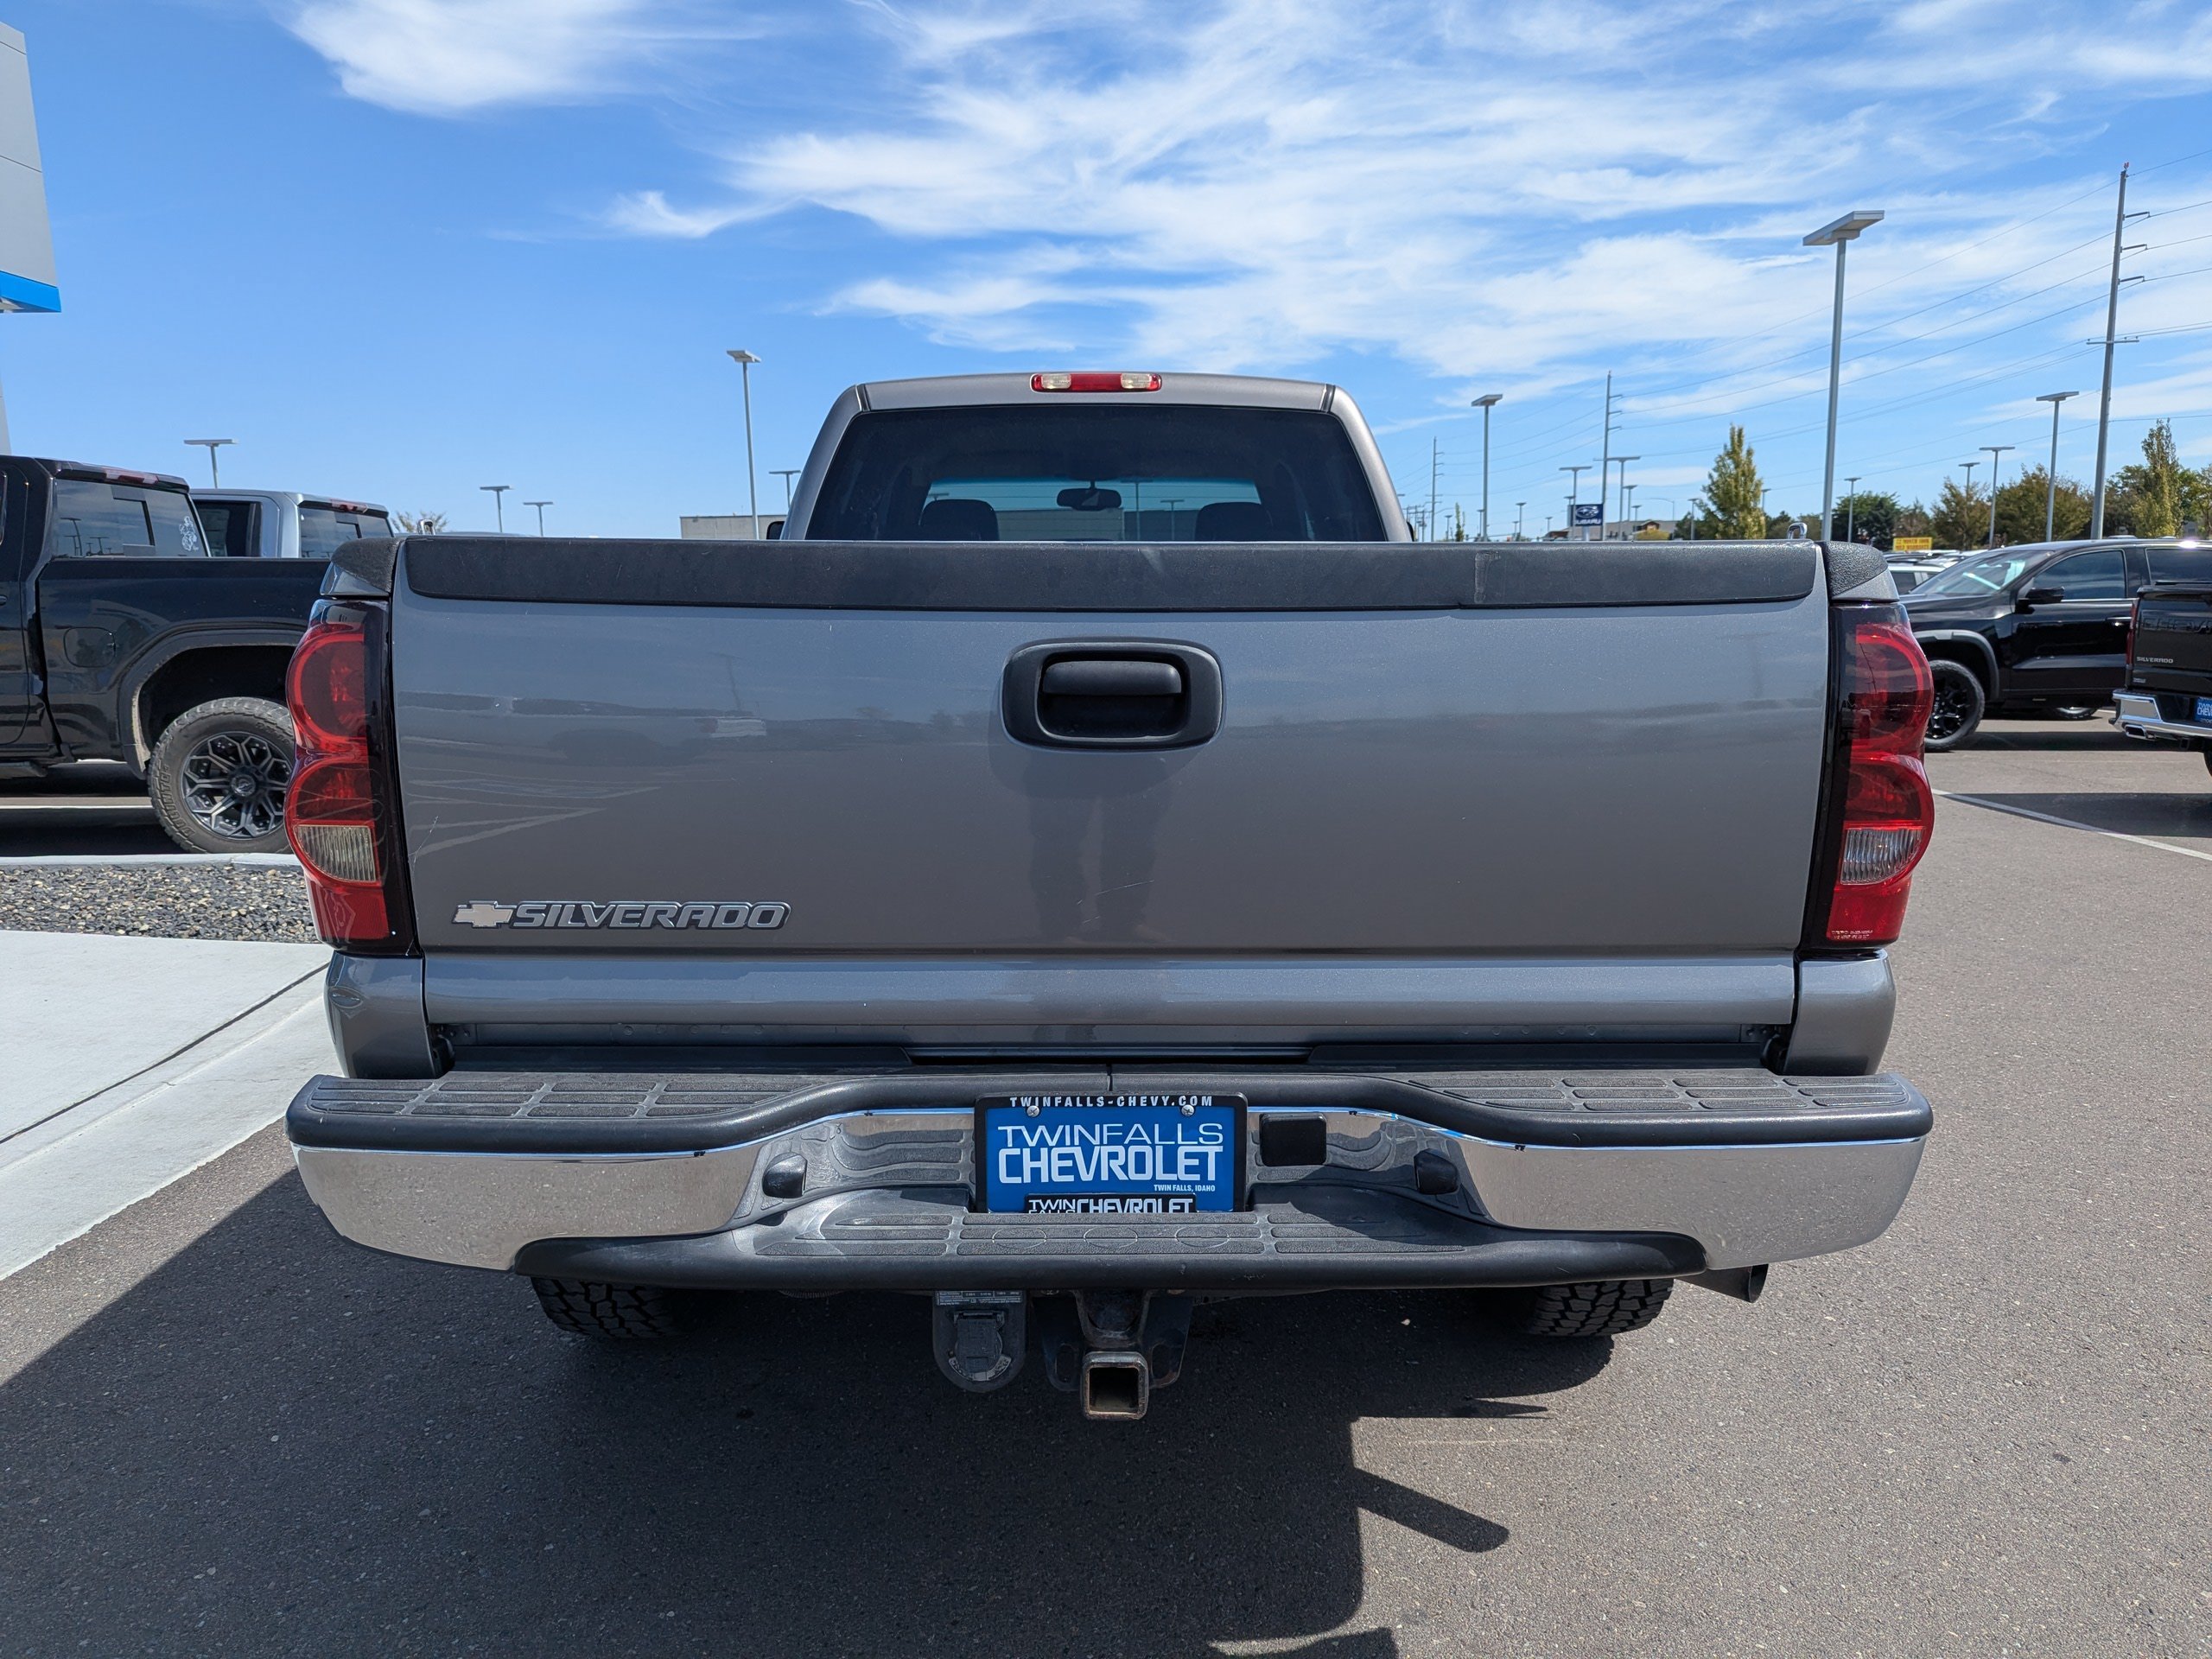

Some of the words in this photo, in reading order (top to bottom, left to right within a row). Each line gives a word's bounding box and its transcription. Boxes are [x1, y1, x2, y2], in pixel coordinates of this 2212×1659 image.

[513, 903, 789, 928] SILVERADO
[1009, 1095, 1213, 1108] TWINFALLS-CHEVY.COM
[997, 1145, 1224, 1184] CHEVROLET
[1173, 1184, 1194, 1192] FALLS,
[1028, 1198, 1076, 1210] TWIN
[1077, 1198, 1193, 1213] CHEVROLET
